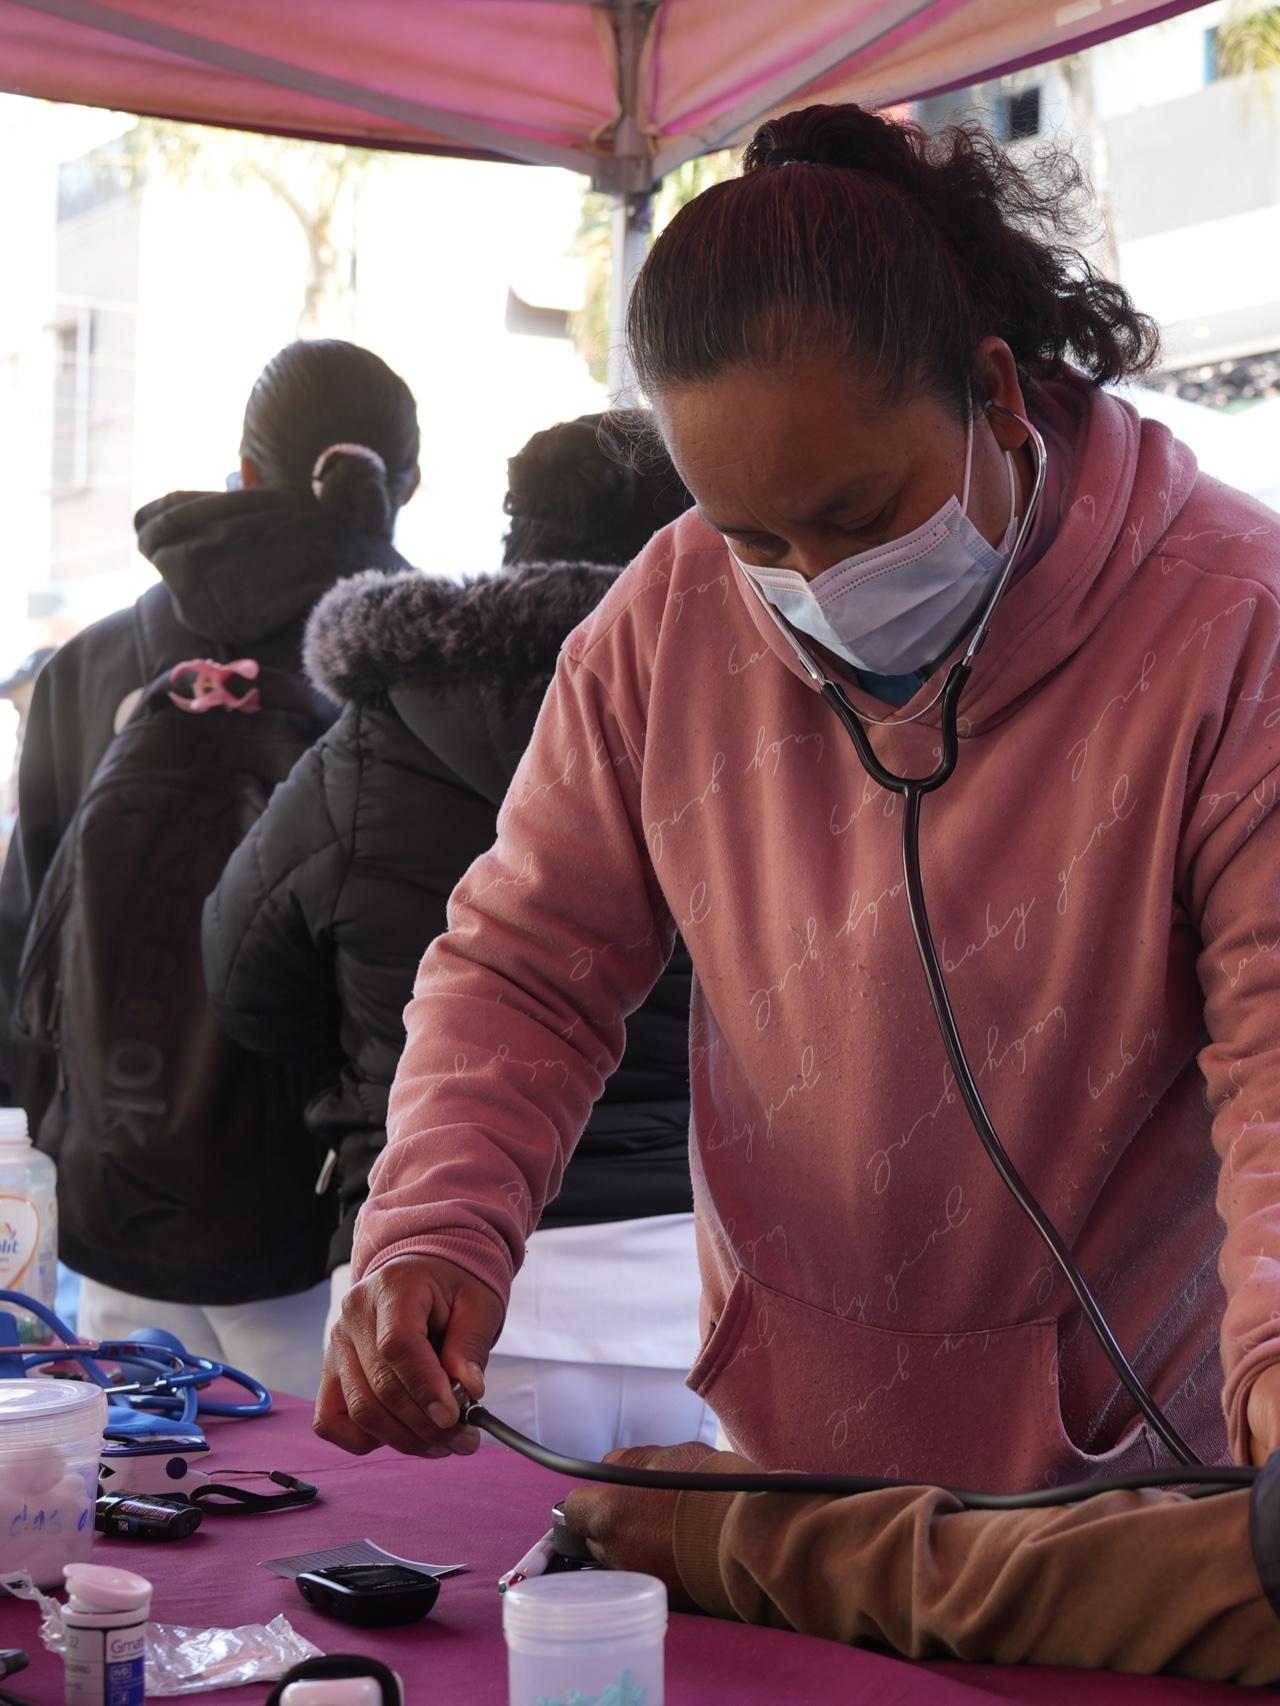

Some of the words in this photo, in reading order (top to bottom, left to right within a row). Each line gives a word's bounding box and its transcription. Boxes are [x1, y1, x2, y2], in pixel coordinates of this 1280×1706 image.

[744, 726, 824, 777] baby
[1066, 652, 1157, 782] girl
[836, 881, 905, 938] aby
[943, 897, 1035, 973] baby
[1057, 773, 1138, 915] girl
[749, 916, 819, 1032] girl
[978, 1006, 1067, 1078] baby
[866, 1061, 957, 1195] girl
[885, 1185, 971, 1313] girl
[825, 1344, 910, 1451] girl
